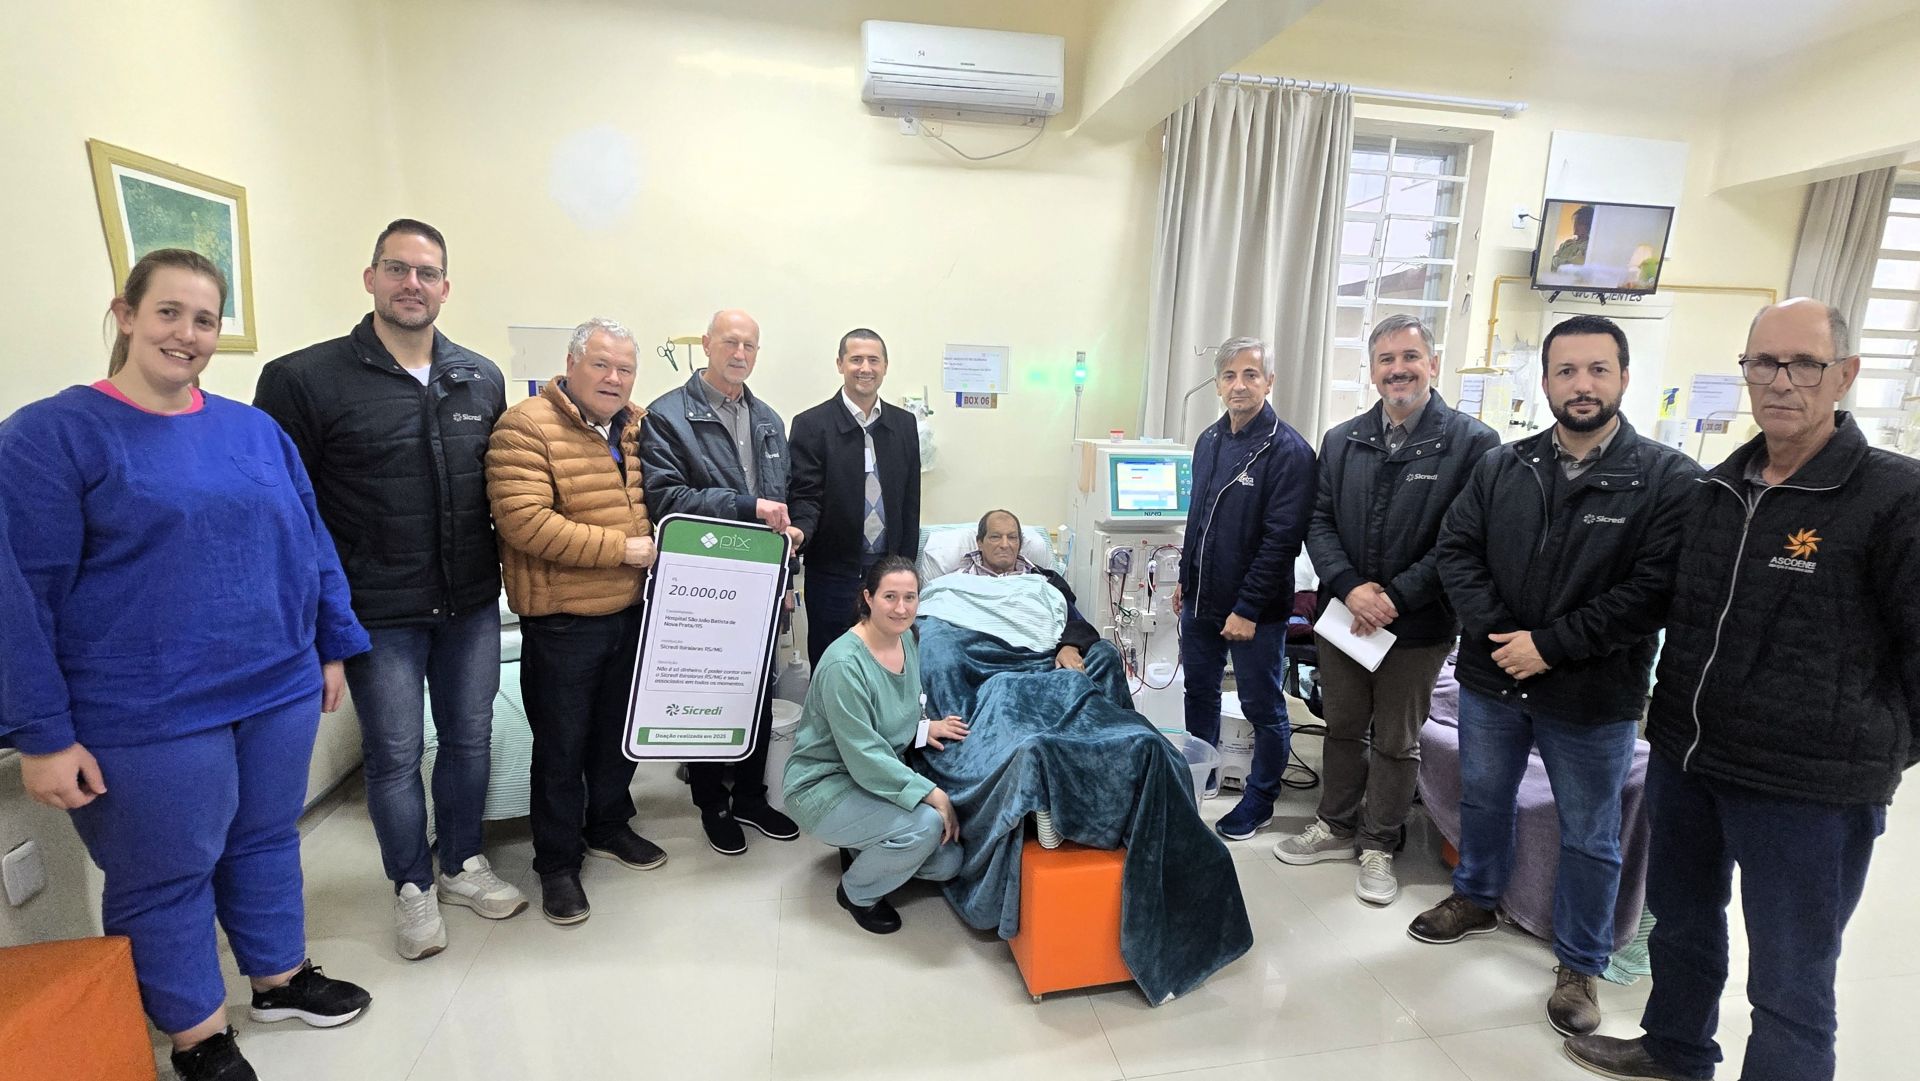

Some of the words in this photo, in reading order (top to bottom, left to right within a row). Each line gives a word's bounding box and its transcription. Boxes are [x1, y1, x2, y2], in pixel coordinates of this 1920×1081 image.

[964, 396, 979, 405] BOX
[980, 396, 990, 405] 06
[719, 534, 752, 550] pix
[668, 584, 737, 600] 20.000,00
[681, 705, 724, 716] Sicredi
